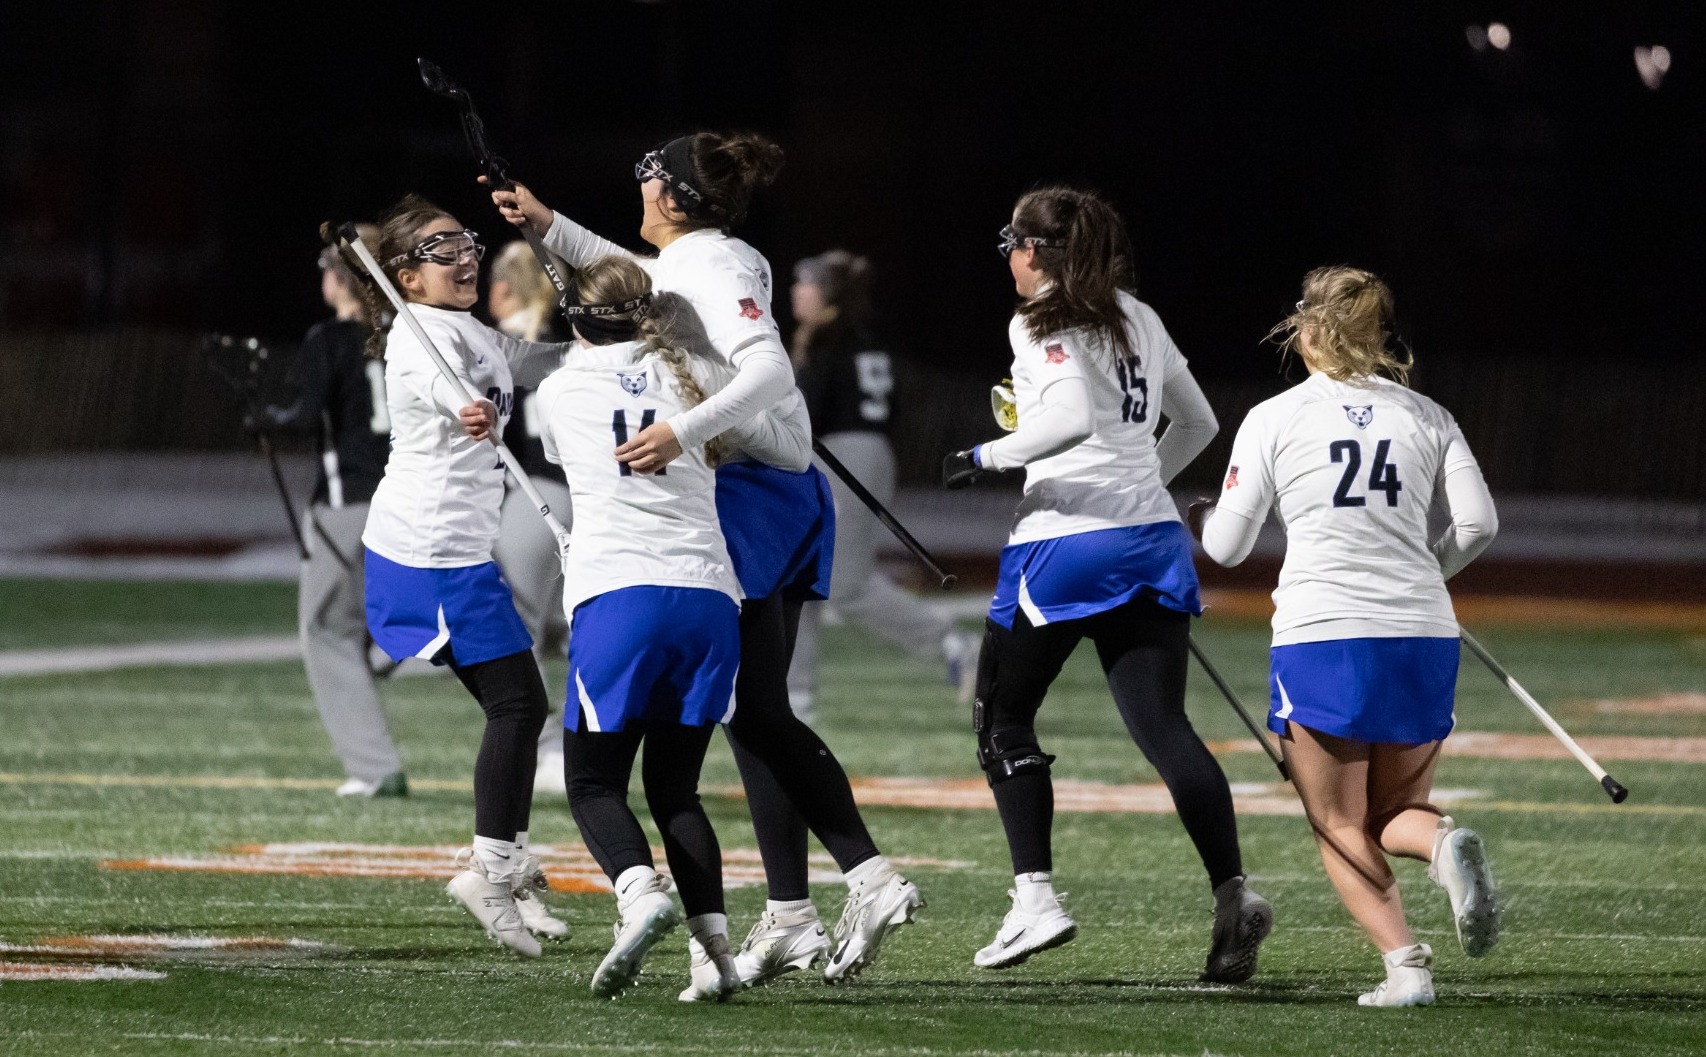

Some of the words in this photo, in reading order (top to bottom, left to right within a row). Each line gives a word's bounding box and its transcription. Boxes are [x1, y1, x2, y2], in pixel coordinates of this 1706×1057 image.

[678, 182, 703, 202] STX
[568, 306, 585, 314] STX
[590, 305, 617, 314] STX
[1117, 355, 1148, 423] 15
[1329, 439, 1403, 508] 24
